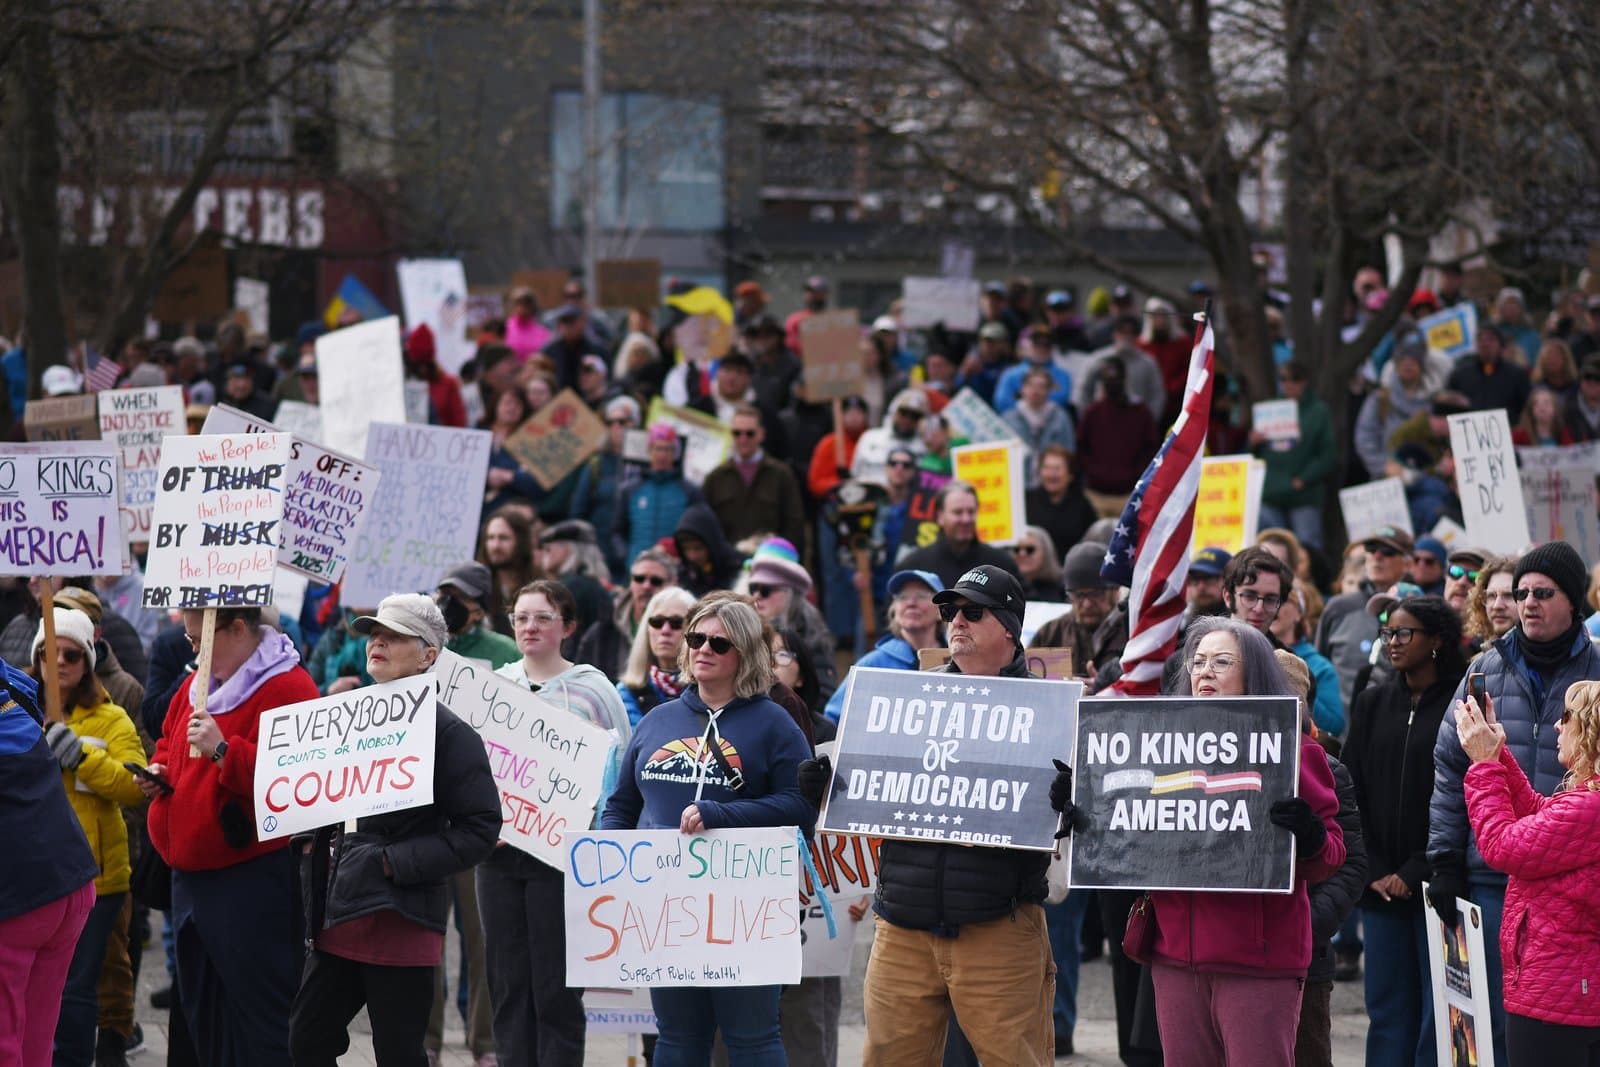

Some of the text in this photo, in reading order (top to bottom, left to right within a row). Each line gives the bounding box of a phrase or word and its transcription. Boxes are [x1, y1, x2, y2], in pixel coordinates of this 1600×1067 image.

[112, 392, 158, 410] WHEN
[102, 411, 174, 432] INJUSTICE
[1456, 416, 1502, 451] TWO
[198, 449, 217, 464] the
[220, 434, 277, 461] People!
[0, 459, 114, 494] O KINGS
[162, 463, 285, 493] OF TRUMP
[1462, 456, 1478, 483] IF
[1487, 452, 1505, 479] BY
[0, 500, 68, 523] HIS IS
[198, 492, 273, 520] the People!
[1478, 483, 1504, 515] DC
[0, 516, 105, 570] MERICA!
[156, 523, 188, 548] BY
[200, 519, 279, 547] MUSK
[179, 550, 273, 581] the People!
[142, 586, 172, 609] FOR
[268, 685, 430, 751] EVERYBODY
[443, 661, 588, 762] If you aren't
[866, 695, 1035, 744] DICTATOR
[277, 730, 407, 767] COUNTS OR NOBODY
[922, 738, 961, 772] OR
[1087, 731, 1282, 765] NO KINGS IN
[265, 755, 421, 813] COUNTS
[539, 767, 582, 804] you
[847, 768, 1030, 813] DEMOCRACY
[1109, 799, 1252, 831] AMERICA
[848, 822, 1013, 846] THAT'S THE CHOICE
[571, 837, 794, 888] CDC and SCIENCE
[584, 892, 700, 962] SAVES
[706, 892, 798, 946] LIVES
[667, 964, 696, 981] Public
[703, 963, 742, 983] Health!
[586, 1011, 657, 1024] ONSTITU
